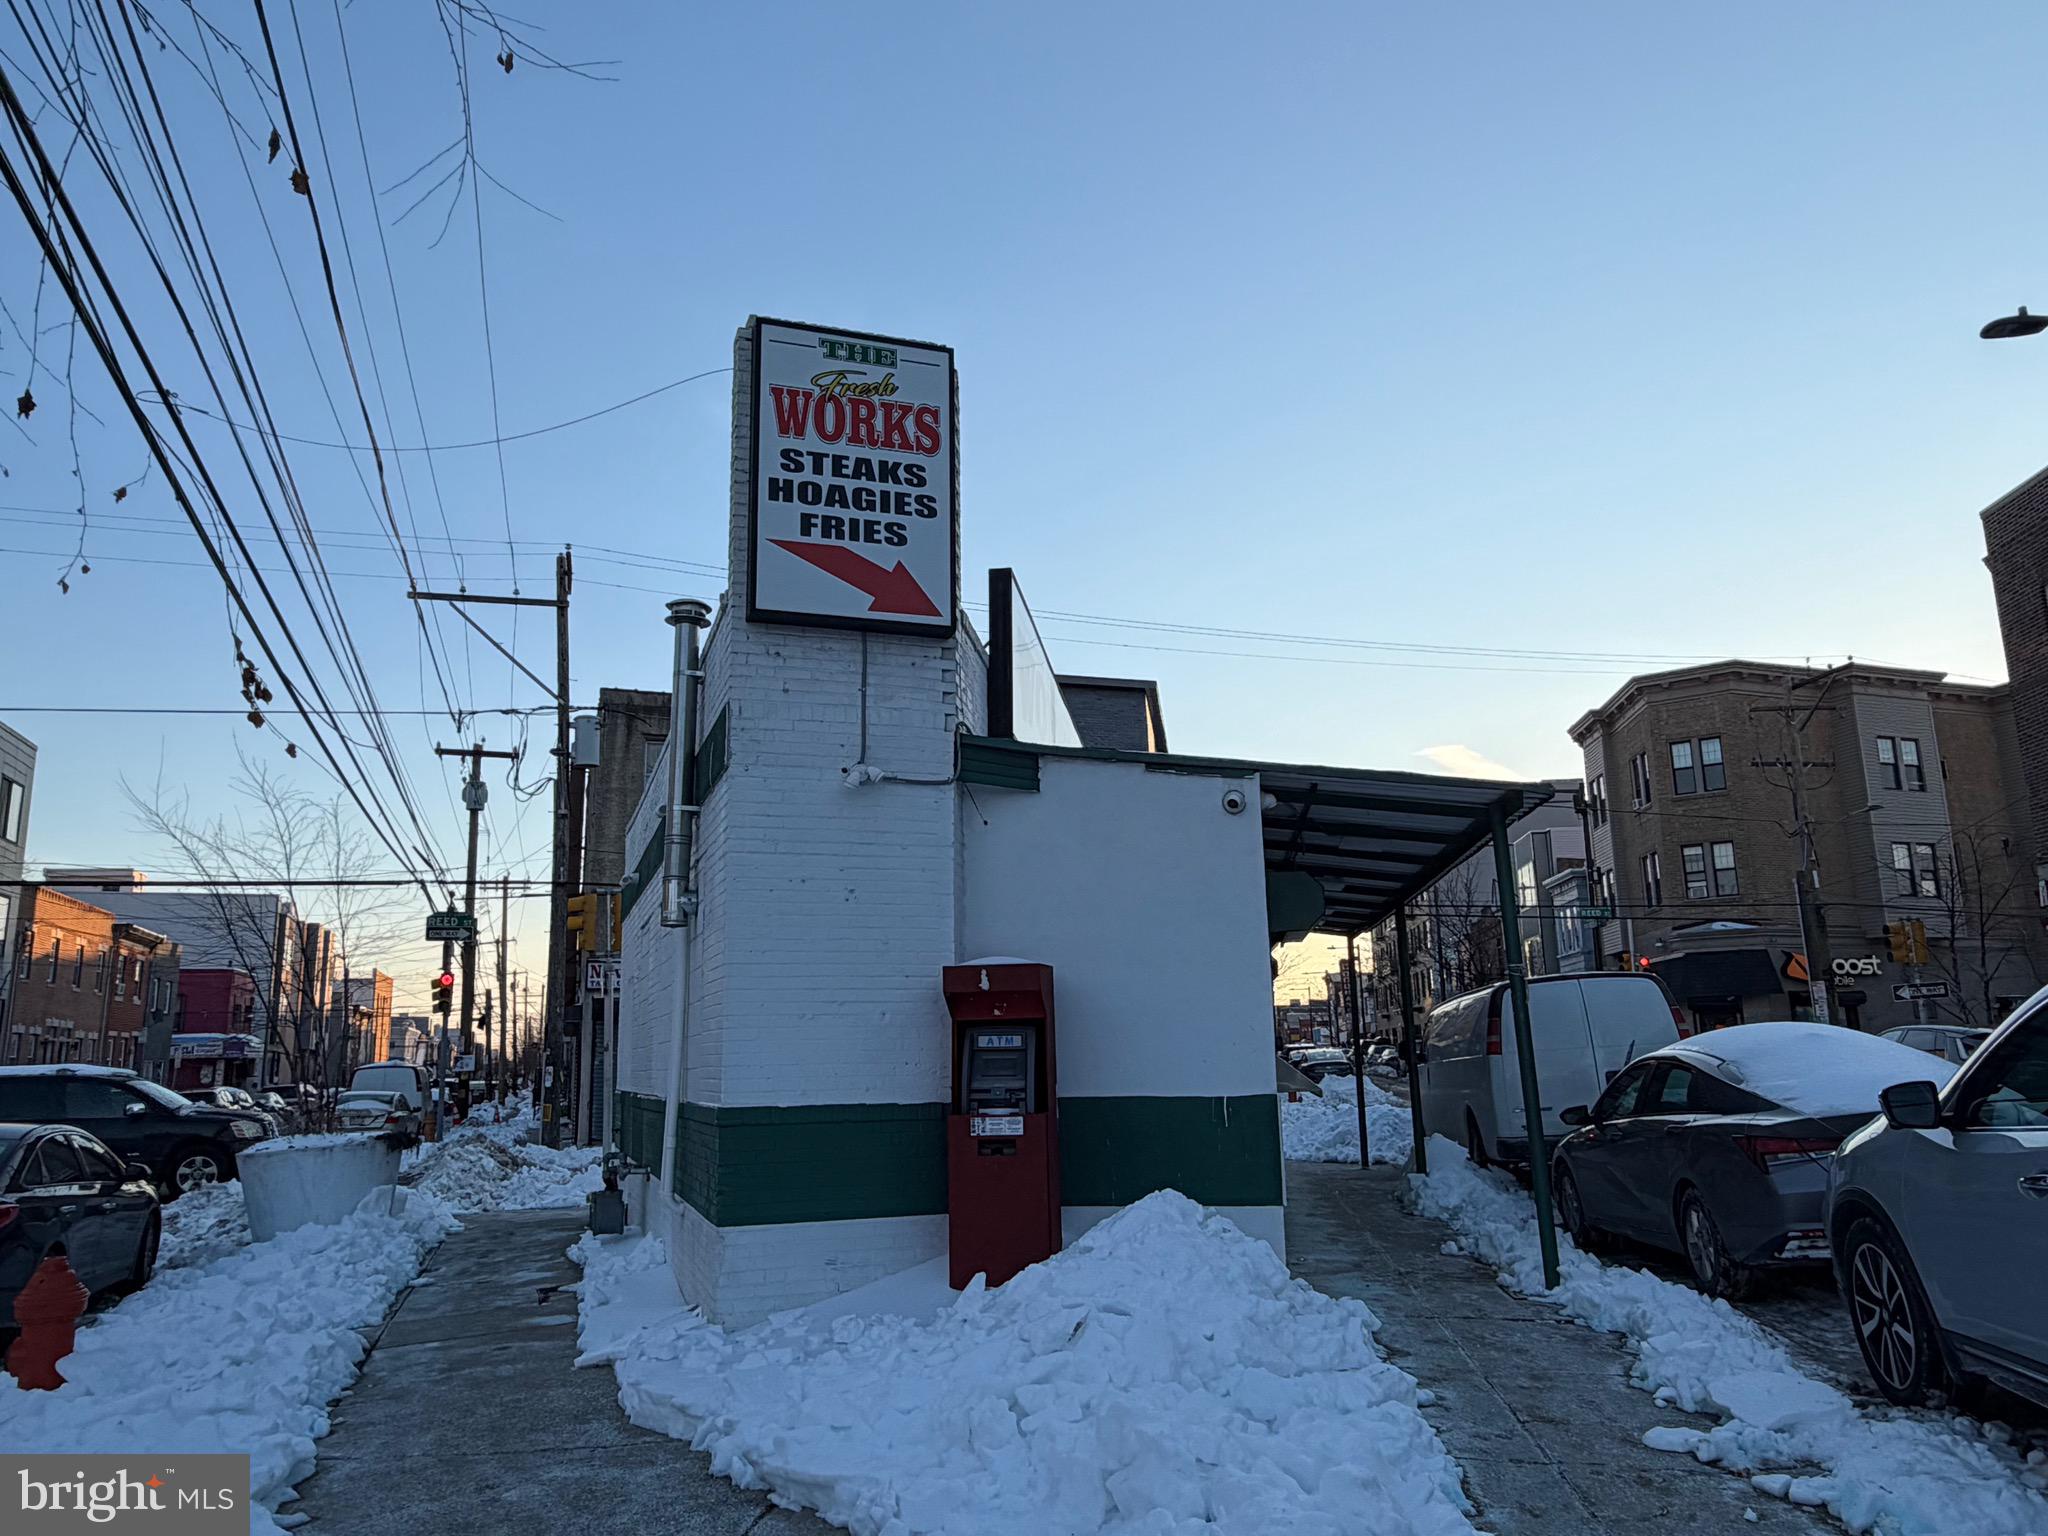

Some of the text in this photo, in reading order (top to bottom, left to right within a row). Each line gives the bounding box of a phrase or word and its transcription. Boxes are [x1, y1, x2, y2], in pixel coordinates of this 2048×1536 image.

[818, 338, 898, 368] THE
[811, 370, 899, 397] Fresh
[769, 384, 941, 457] WORKS
[780, 448, 927, 488] STEAKS
[768, 477, 938, 519] HOAGIES
[800, 512, 908, 547] FRIES
[429, 917, 458, 926] REED
[1832, 955, 1882, 975] oost
[986, 1036, 1015, 1046] ATM
